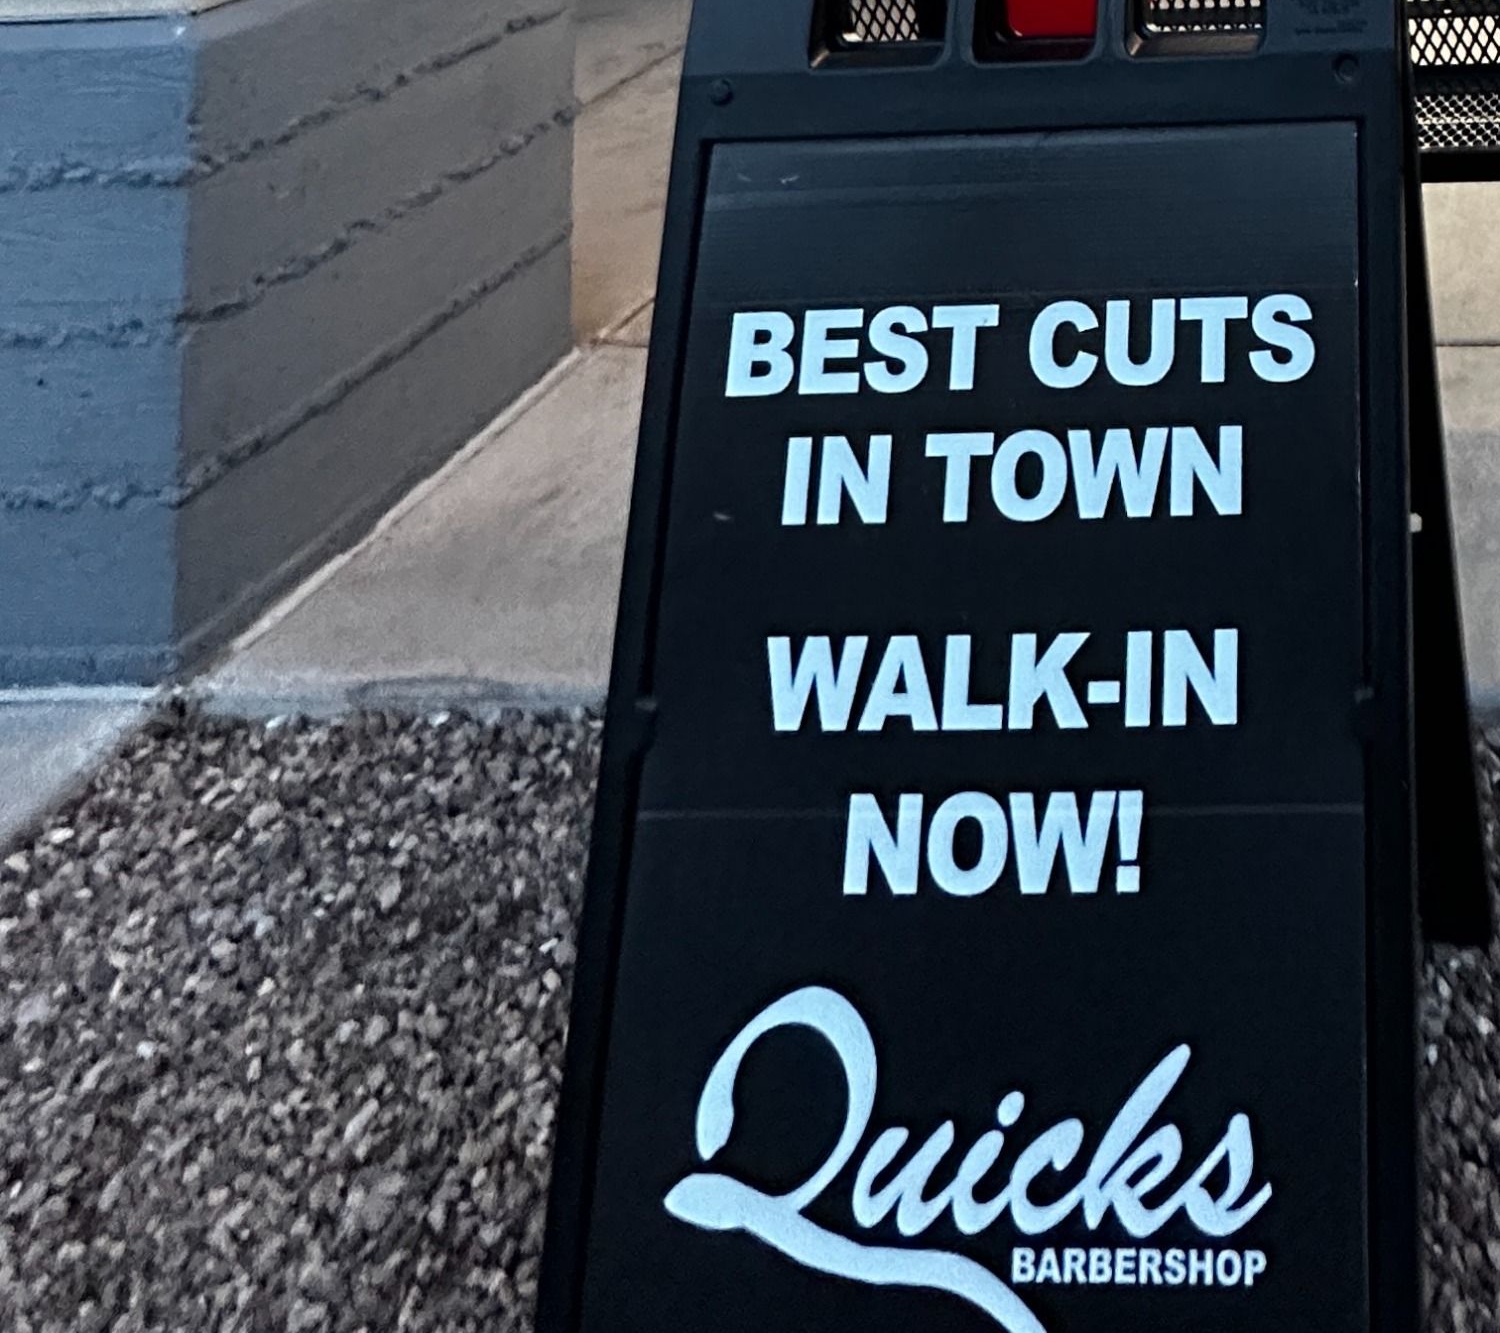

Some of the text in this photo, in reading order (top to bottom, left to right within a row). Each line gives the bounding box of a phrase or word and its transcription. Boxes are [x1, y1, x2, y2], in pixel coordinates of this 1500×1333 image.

[726, 295, 1317, 397] BEST CUTS
[780, 426, 1244, 526] IN TOWN
[767, 628, 1240, 731] WALK-IN
[842, 790, 1145, 896] NOW!
[663, 985, 1273, 1333] Quicks
[1011, 1247, 1267, 1286] BARBERSHOP
